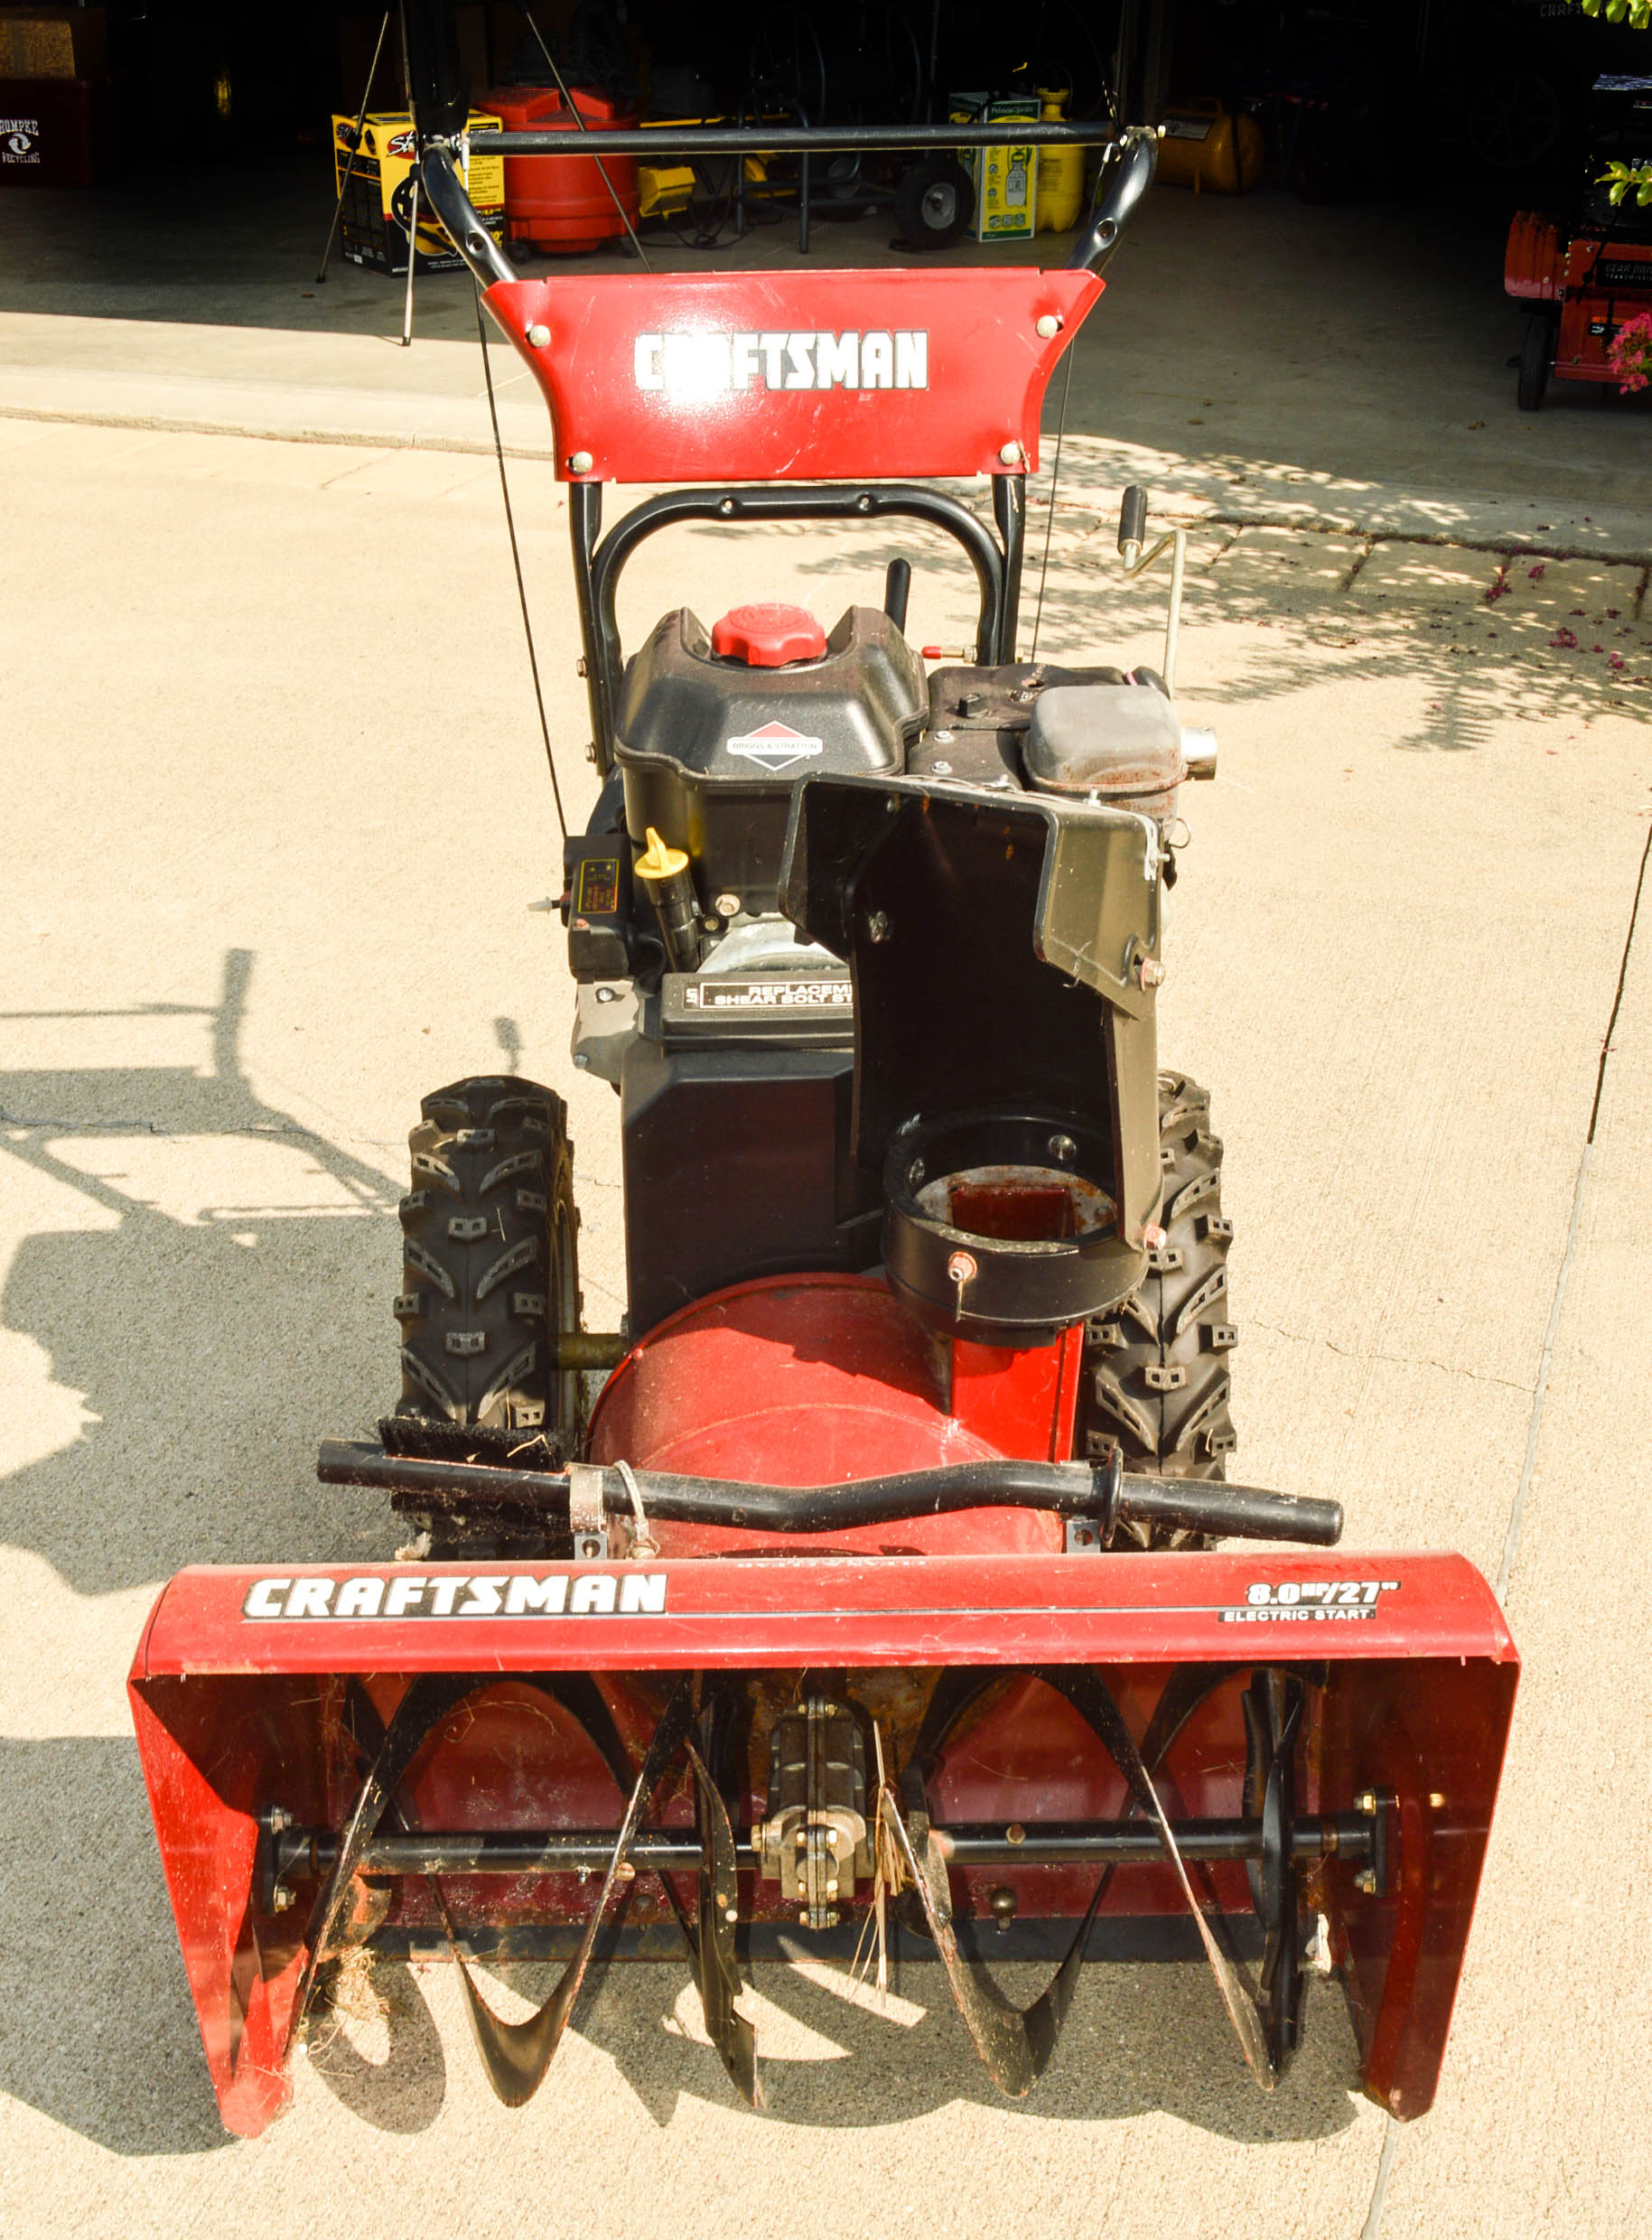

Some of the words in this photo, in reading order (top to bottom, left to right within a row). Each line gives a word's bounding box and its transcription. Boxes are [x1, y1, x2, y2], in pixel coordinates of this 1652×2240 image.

[733, 742, 765, 751] BRIGGS
[775, 742, 817, 751] STRATTON
[714, 994, 777, 1005] SHEAR
[781, 994, 828, 1004] BOLT
[242, 1574, 667, 1618] CRAFTSMAN
[1223, 1610, 1310, 1622] ELECTRIC
[1313, 1609, 1371, 1620] START
